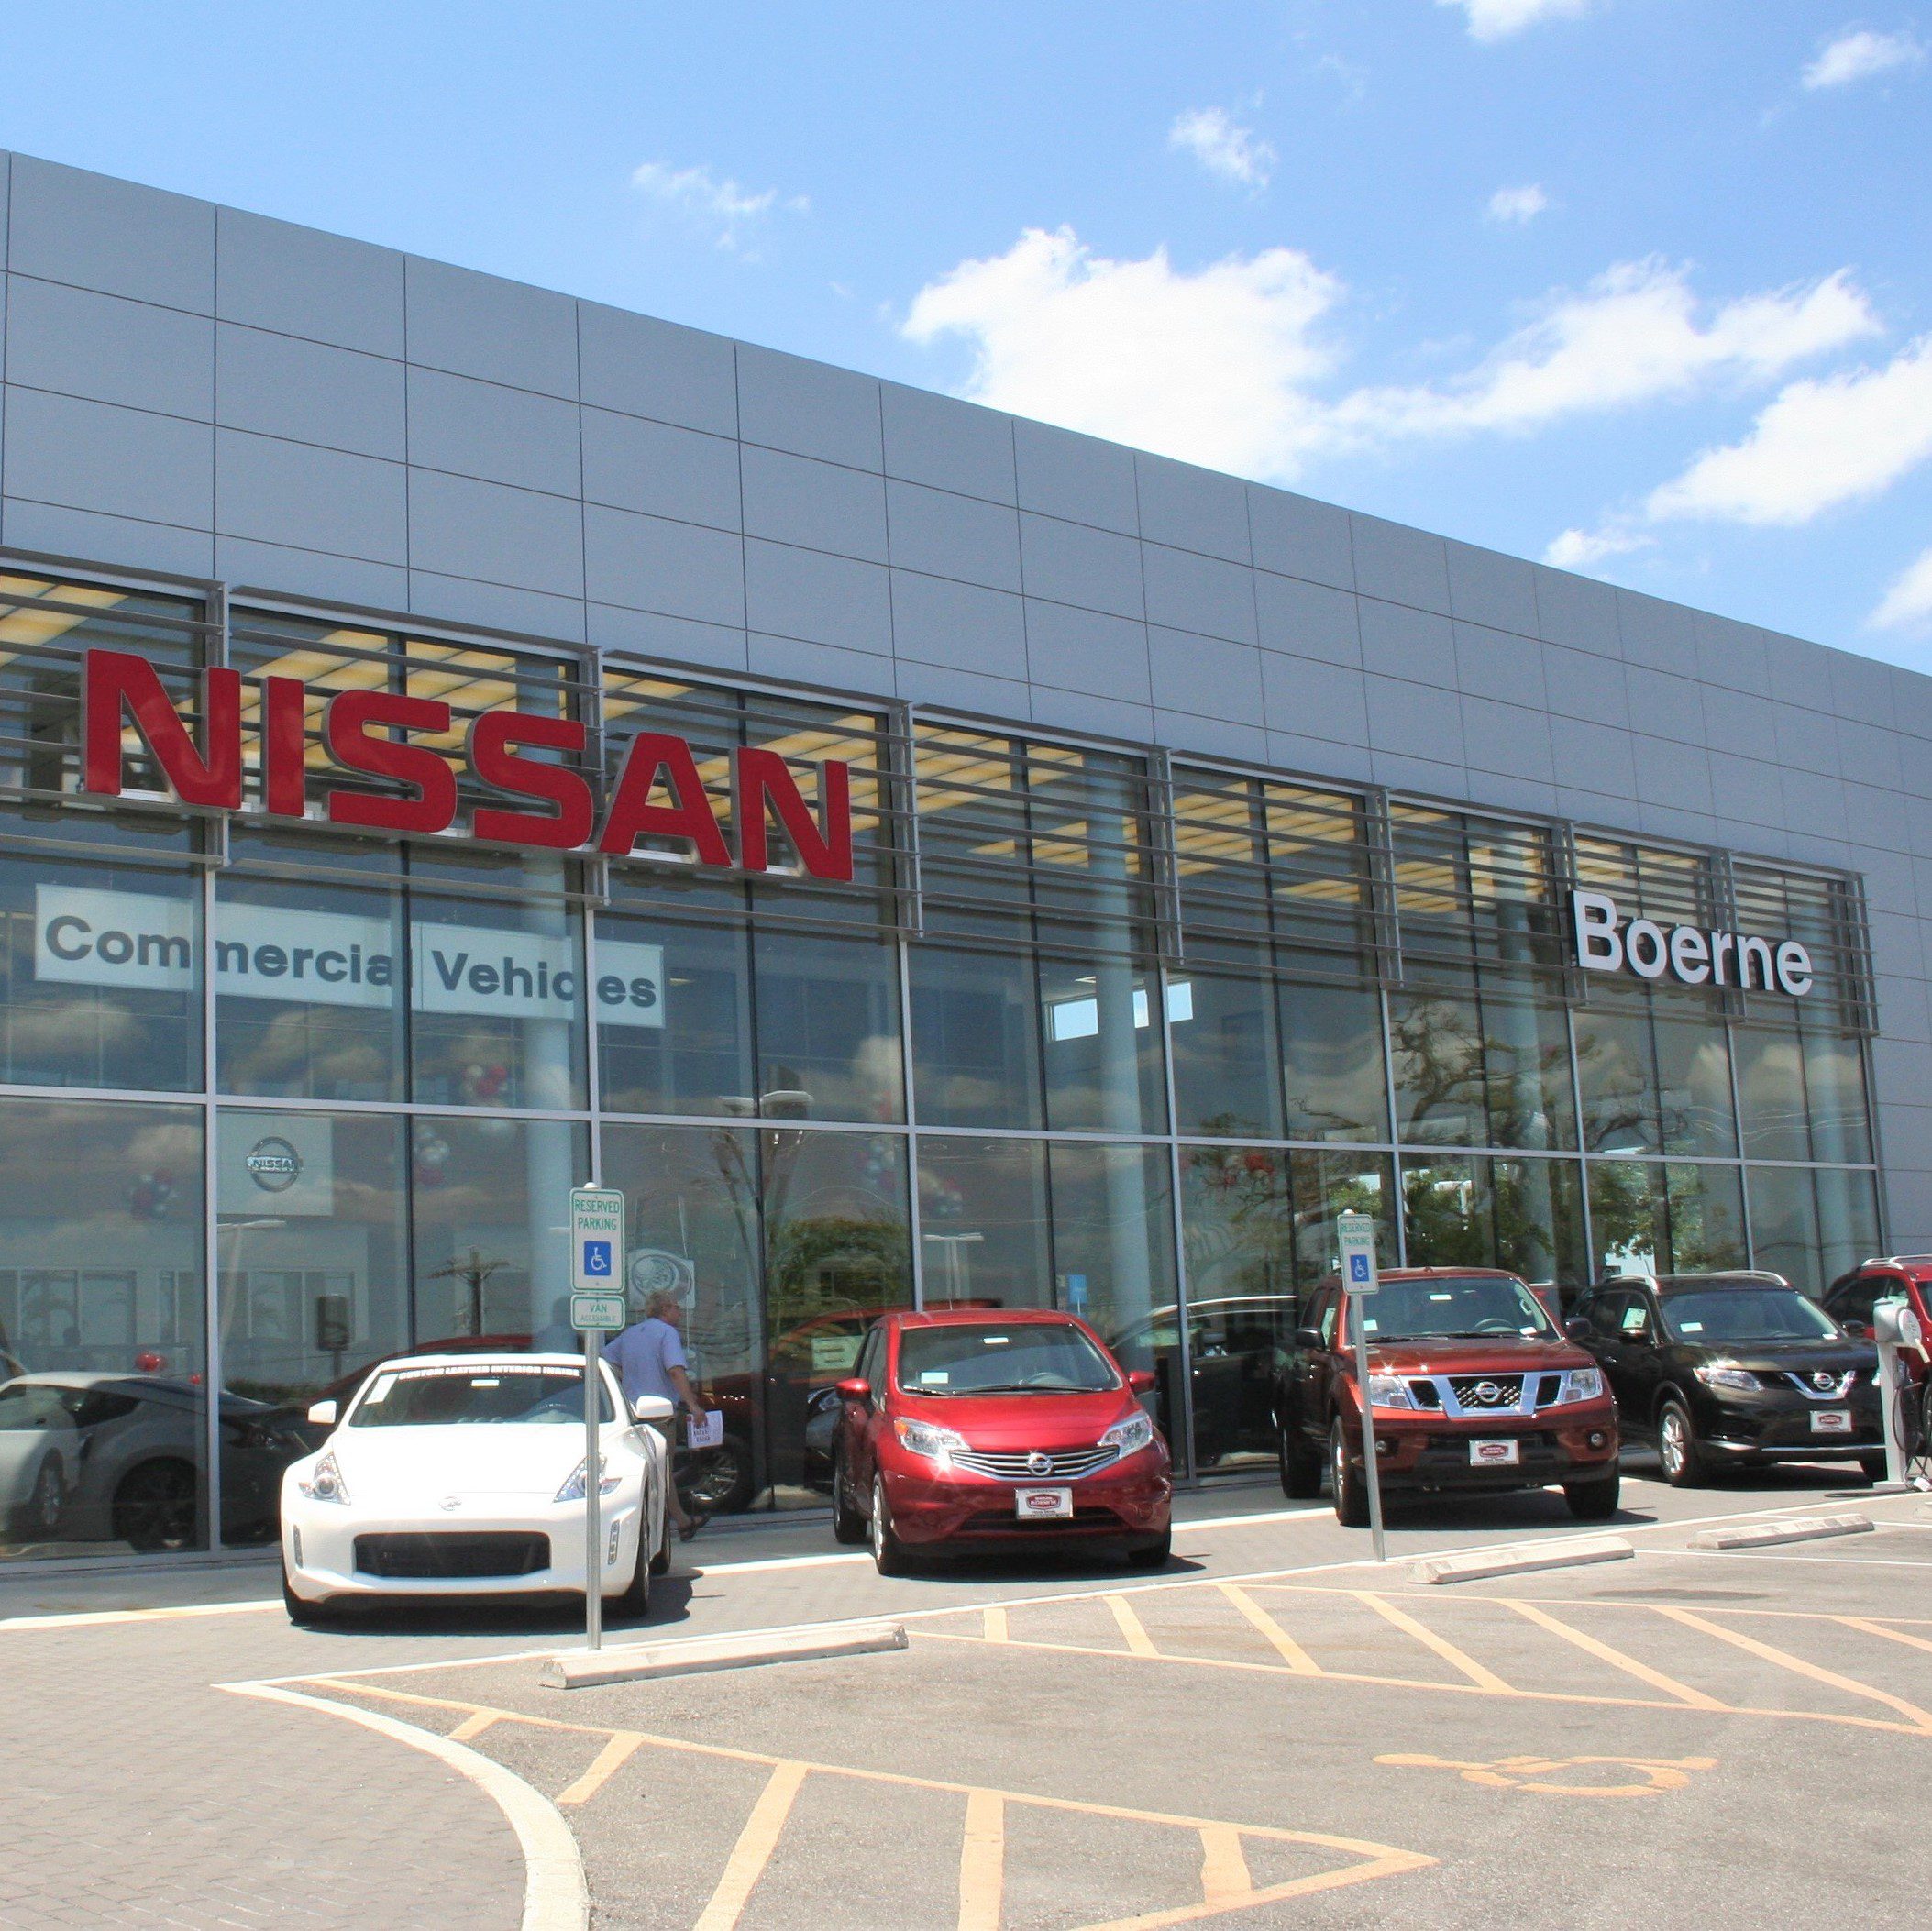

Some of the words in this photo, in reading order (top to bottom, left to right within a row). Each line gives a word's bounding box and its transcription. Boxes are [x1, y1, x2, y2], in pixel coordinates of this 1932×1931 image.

[83, 648, 854, 881] NISSAN
[45, 915, 395, 988] Commercia
[431, 950, 657, 1007] Vehices
[1573, 889, 1813, 996] Boerne
[574, 1199, 620, 1214] RESERVED
[578, 1217, 617, 1230] PARKING
[590, 1303, 608, 1313] VAN
